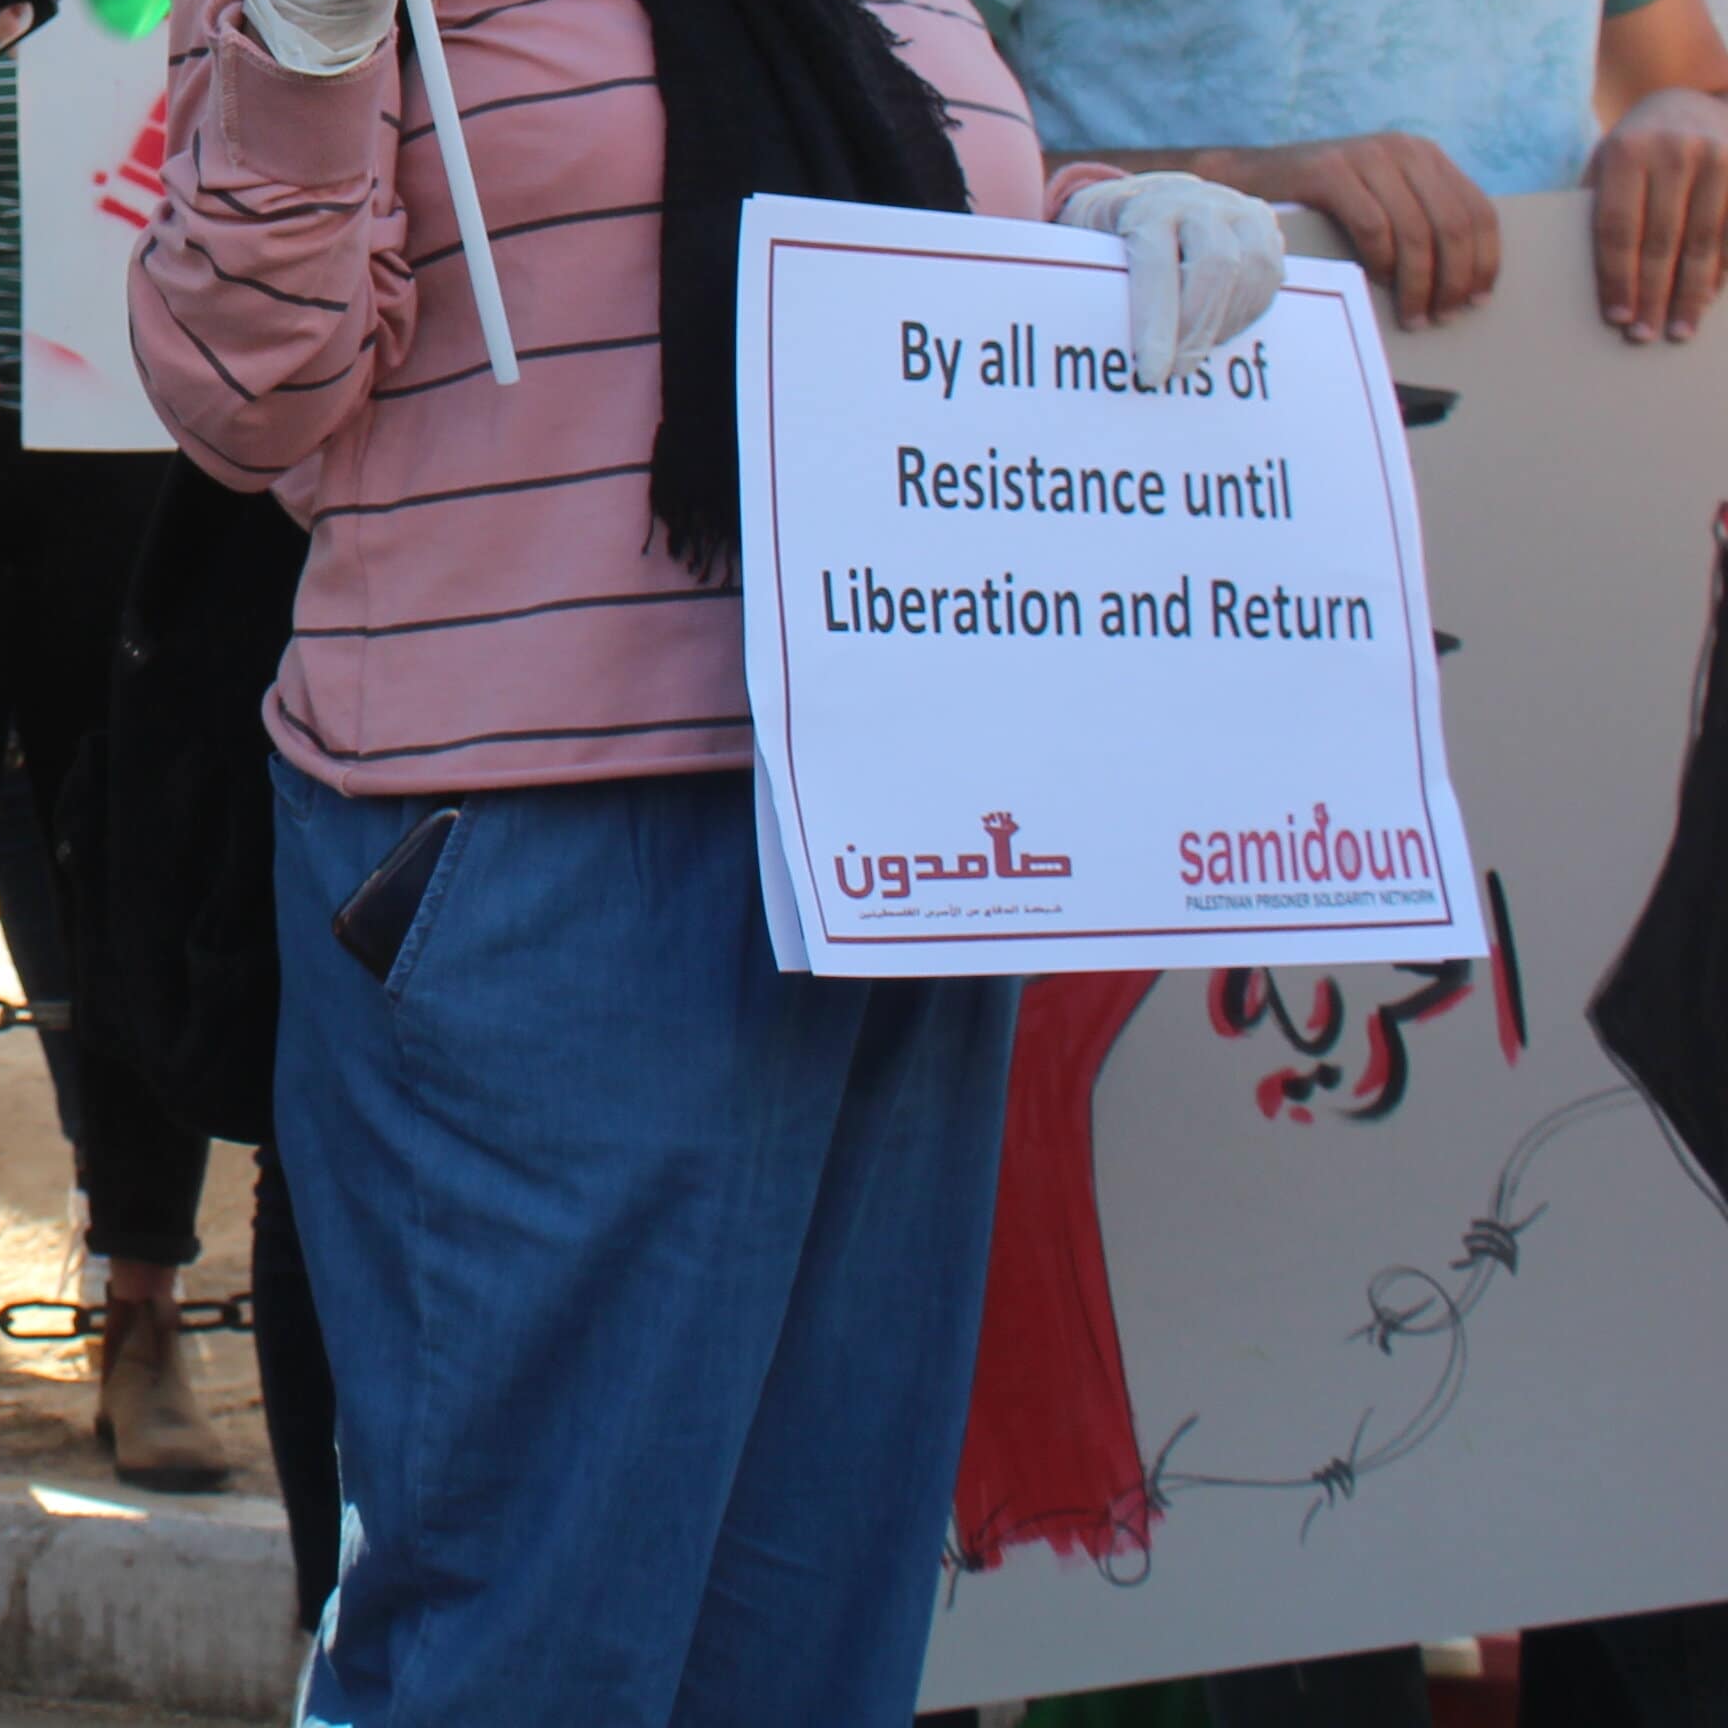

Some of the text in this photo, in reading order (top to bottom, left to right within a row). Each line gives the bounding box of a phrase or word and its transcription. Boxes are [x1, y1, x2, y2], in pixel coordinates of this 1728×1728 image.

[901, 321, 962, 400] By
[980, 323, 1036, 388] all
[1229, 340, 1269, 401] of
[897, 445, 1293, 520] Resistance until
[822, 567, 1374, 641] Liberation and Return
[834, 811, 1072, 899] صامدون
[1179, 802, 1431, 886] samidoun
[1186, 888, 1435, 911] PALESTINIAN PRISONER SOLIDARITY NETWORK
